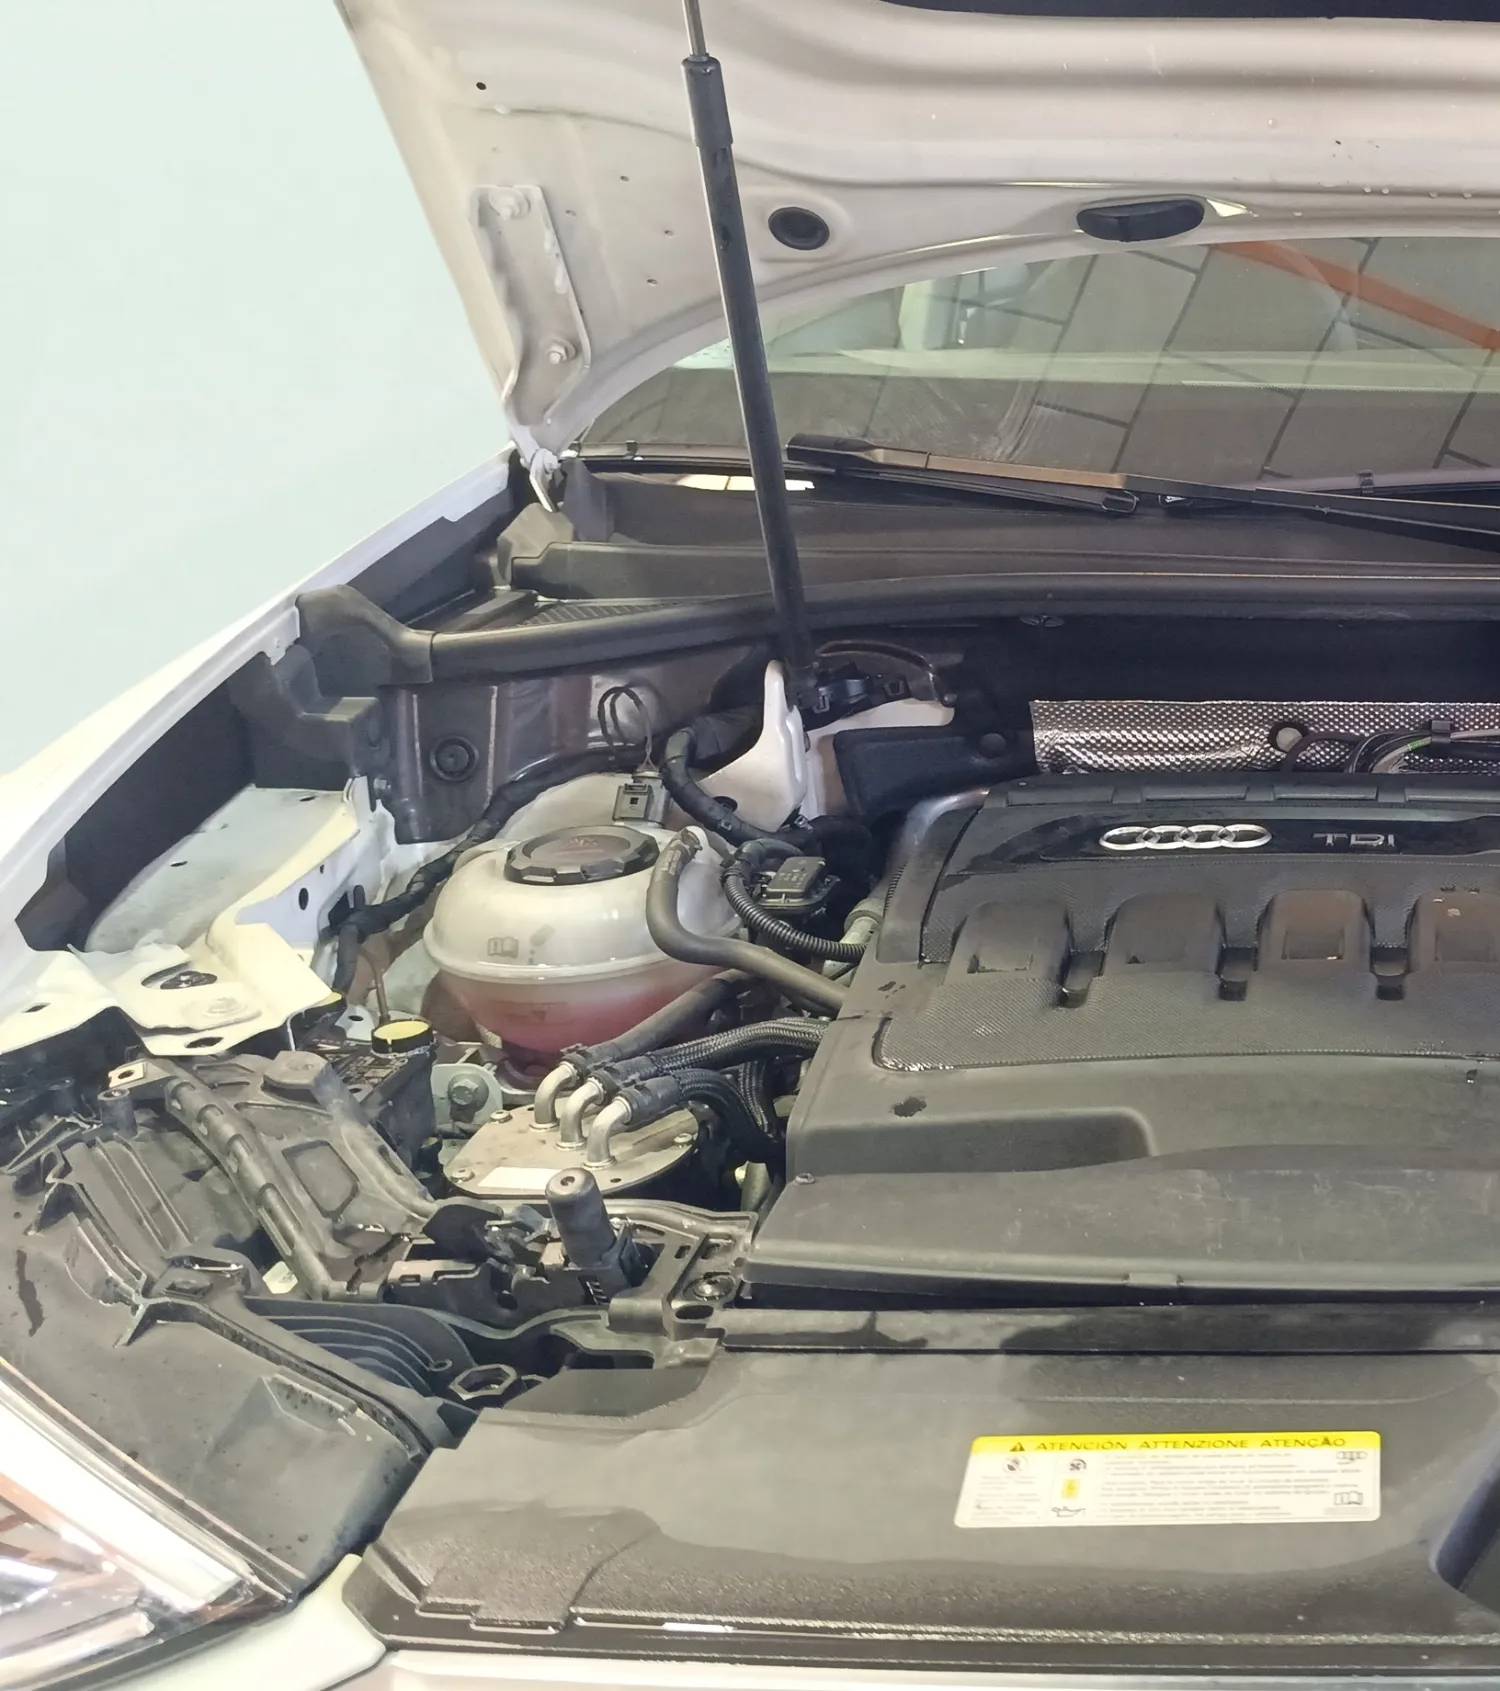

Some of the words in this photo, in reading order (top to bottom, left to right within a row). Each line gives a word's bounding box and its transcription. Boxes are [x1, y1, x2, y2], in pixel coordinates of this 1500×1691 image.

[1313, 832, 1396, 848] TDI
[1035, 1439, 1128, 1451] ATENCIÓN
[1138, 1438, 1249, 1449] ATTENZIONE
[1259, 1435, 1346, 1448] ATENÇÃO
